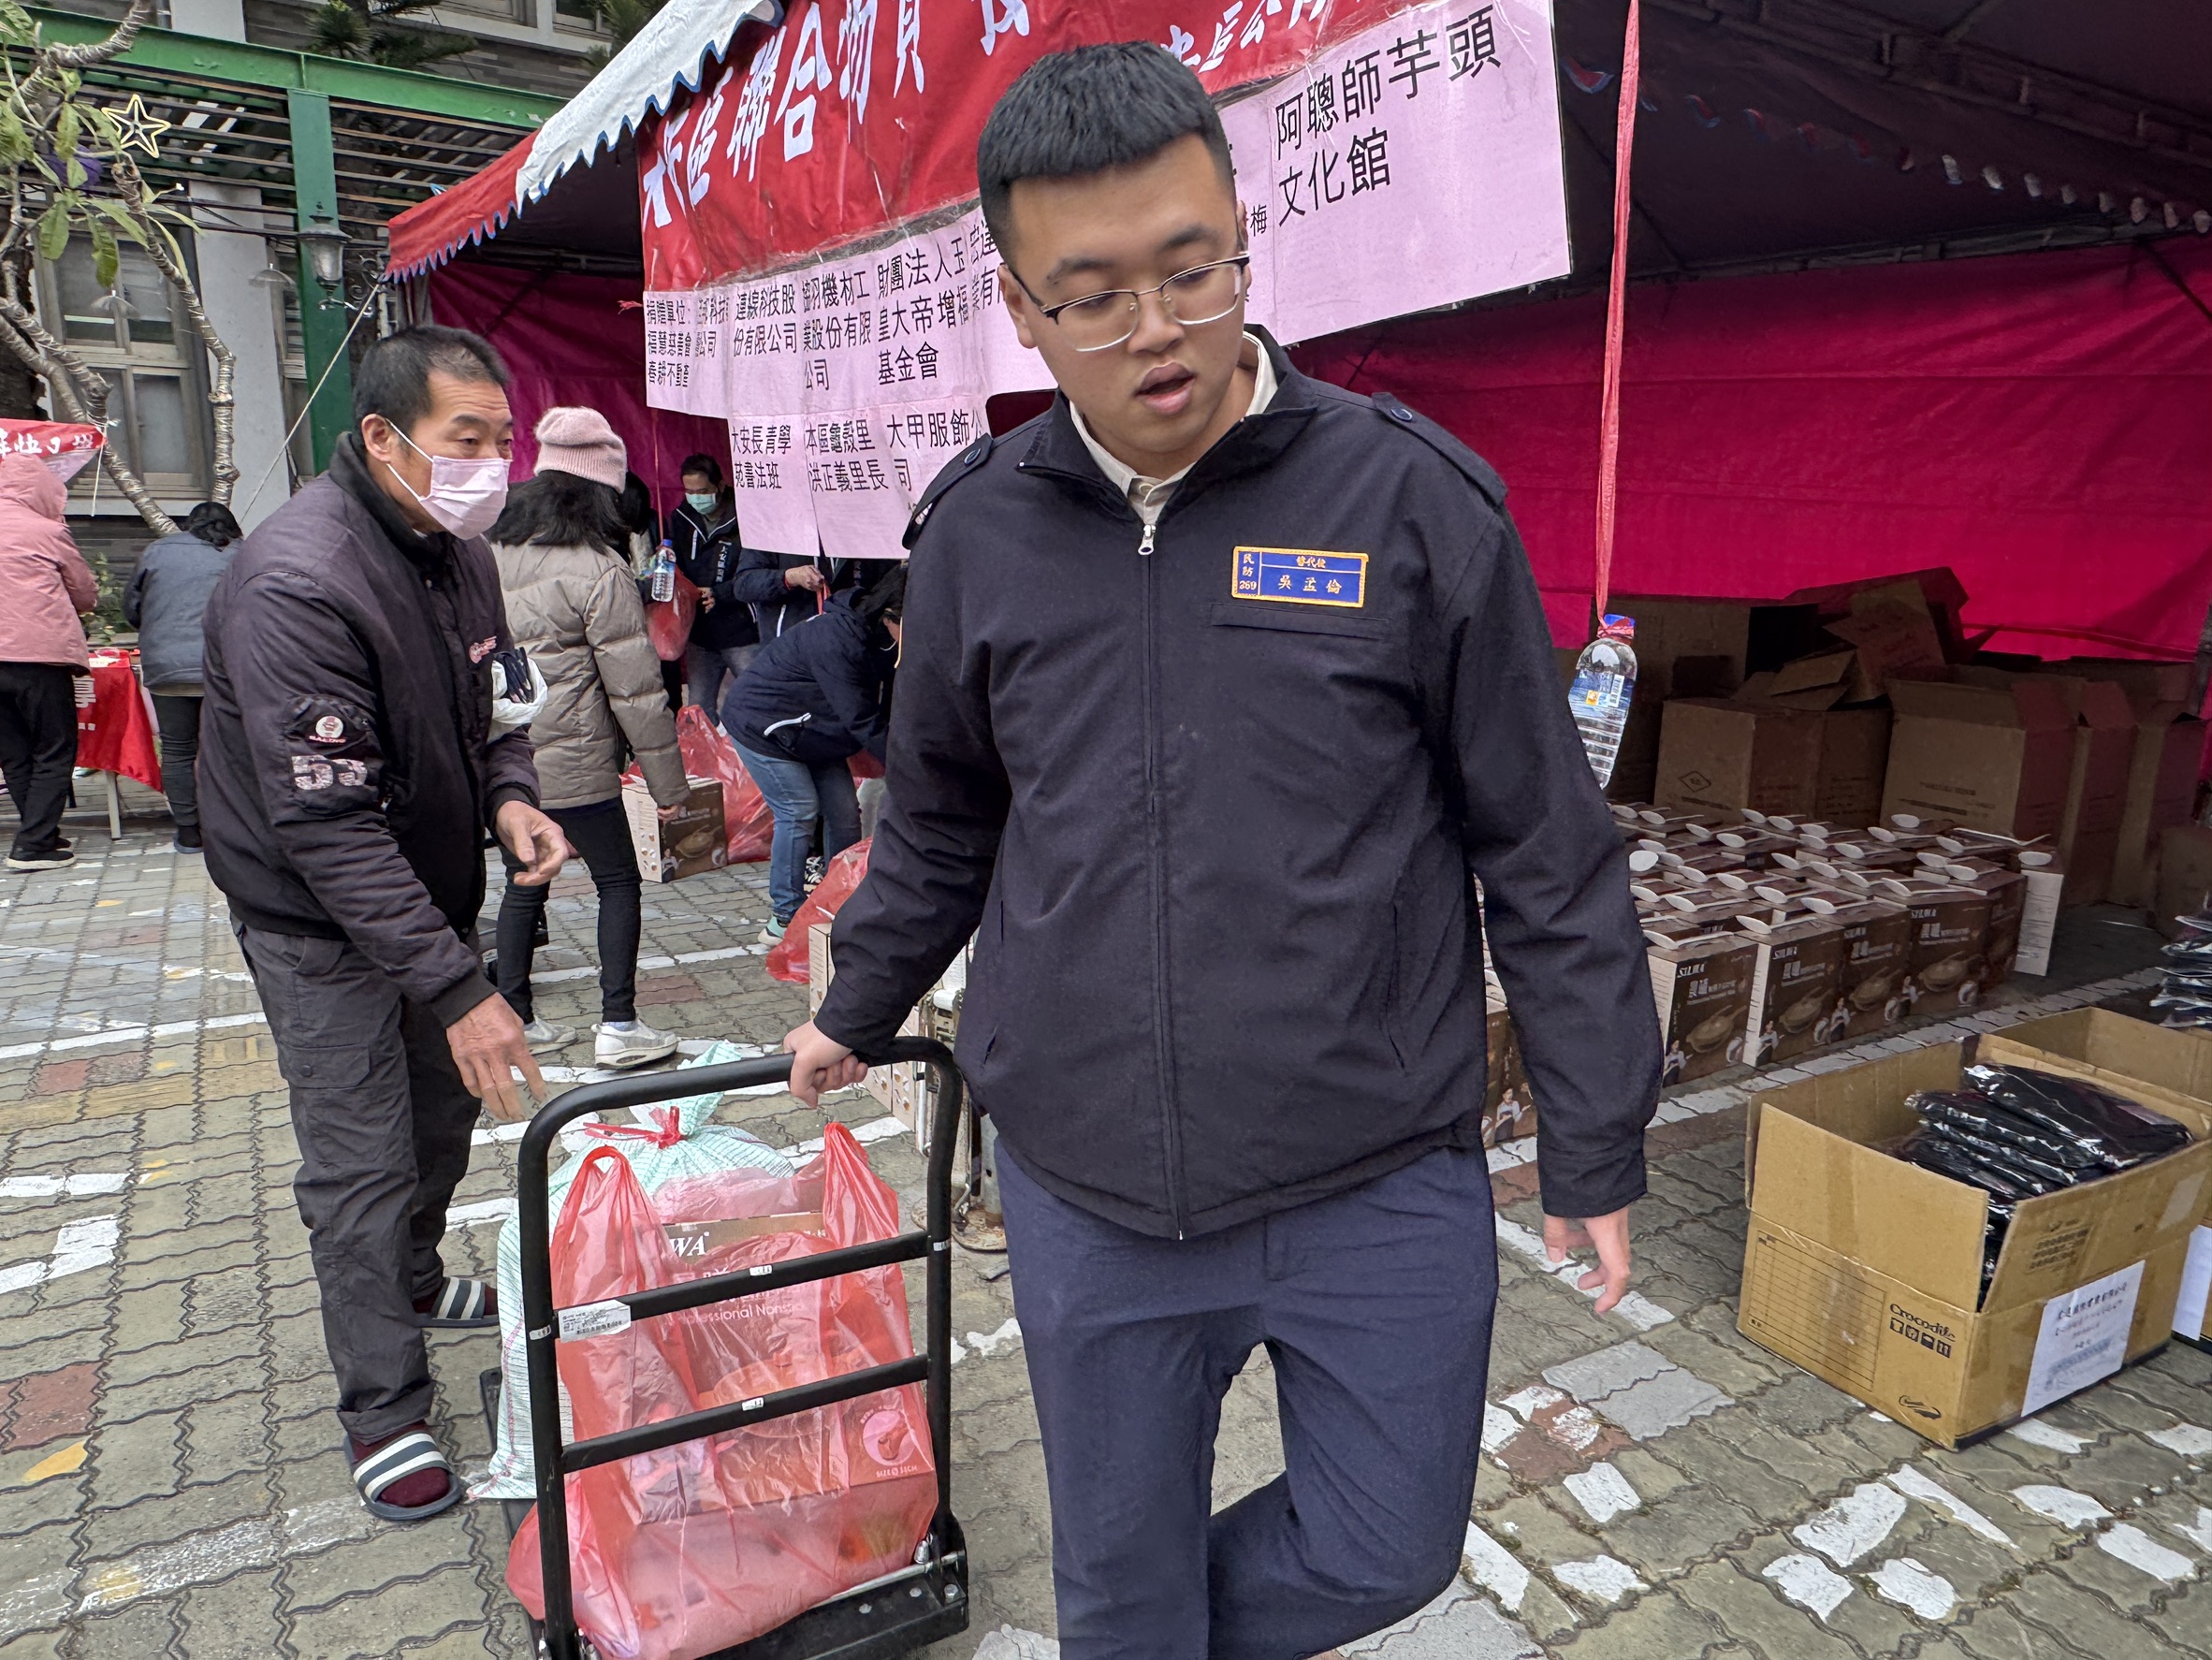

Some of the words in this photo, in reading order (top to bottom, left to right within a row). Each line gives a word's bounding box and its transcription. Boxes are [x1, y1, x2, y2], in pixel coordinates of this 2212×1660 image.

[1276, 4, 1502, 161] 阿聰師芋頭
[1278, 127, 1391, 227] 文化館
[878, 237, 967, 299] 財團法人玉
[878, 284, 969, 342] 皇大帝增福
[734, 322, 797, 357] 份有限公司
[805, 358, 830, 391] 公司
[879, 341, 939, 386] 基金會
[732, 424, 792, 456] 大安長青學
[808, 459, 889, 493] 洪正義里長
[894, 458, 912, 492] 司
[1278, 574, 1343, 595] 吳孟倫
[1890, 1303, 1957, 1343] Crocodile
